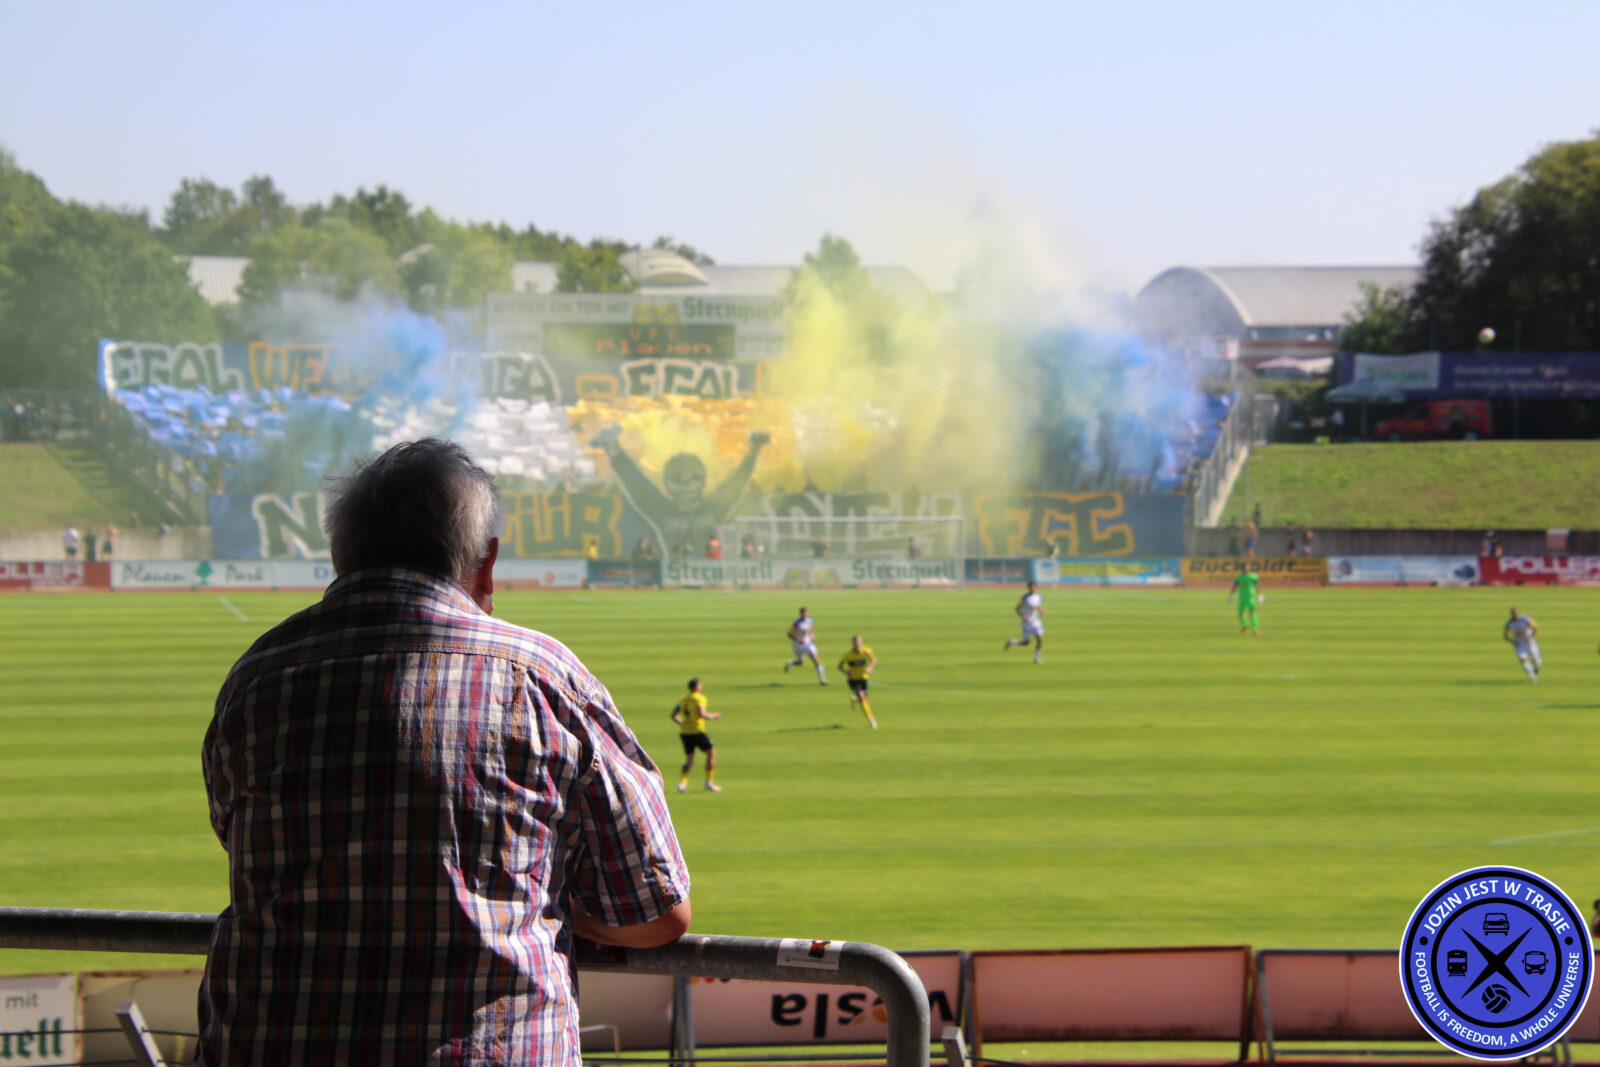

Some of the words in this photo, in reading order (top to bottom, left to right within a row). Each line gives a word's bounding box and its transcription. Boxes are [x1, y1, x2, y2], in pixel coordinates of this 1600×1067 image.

[596, 339, 713, 355] Plauen
[102, 341, 246, 396] EGAL
[121, 561, 187, 582] Plauen
[225, 561, 264, 582] Park
[852, 558, 957, 583] Sternquell
[6, 992, 38, 1008] mit
